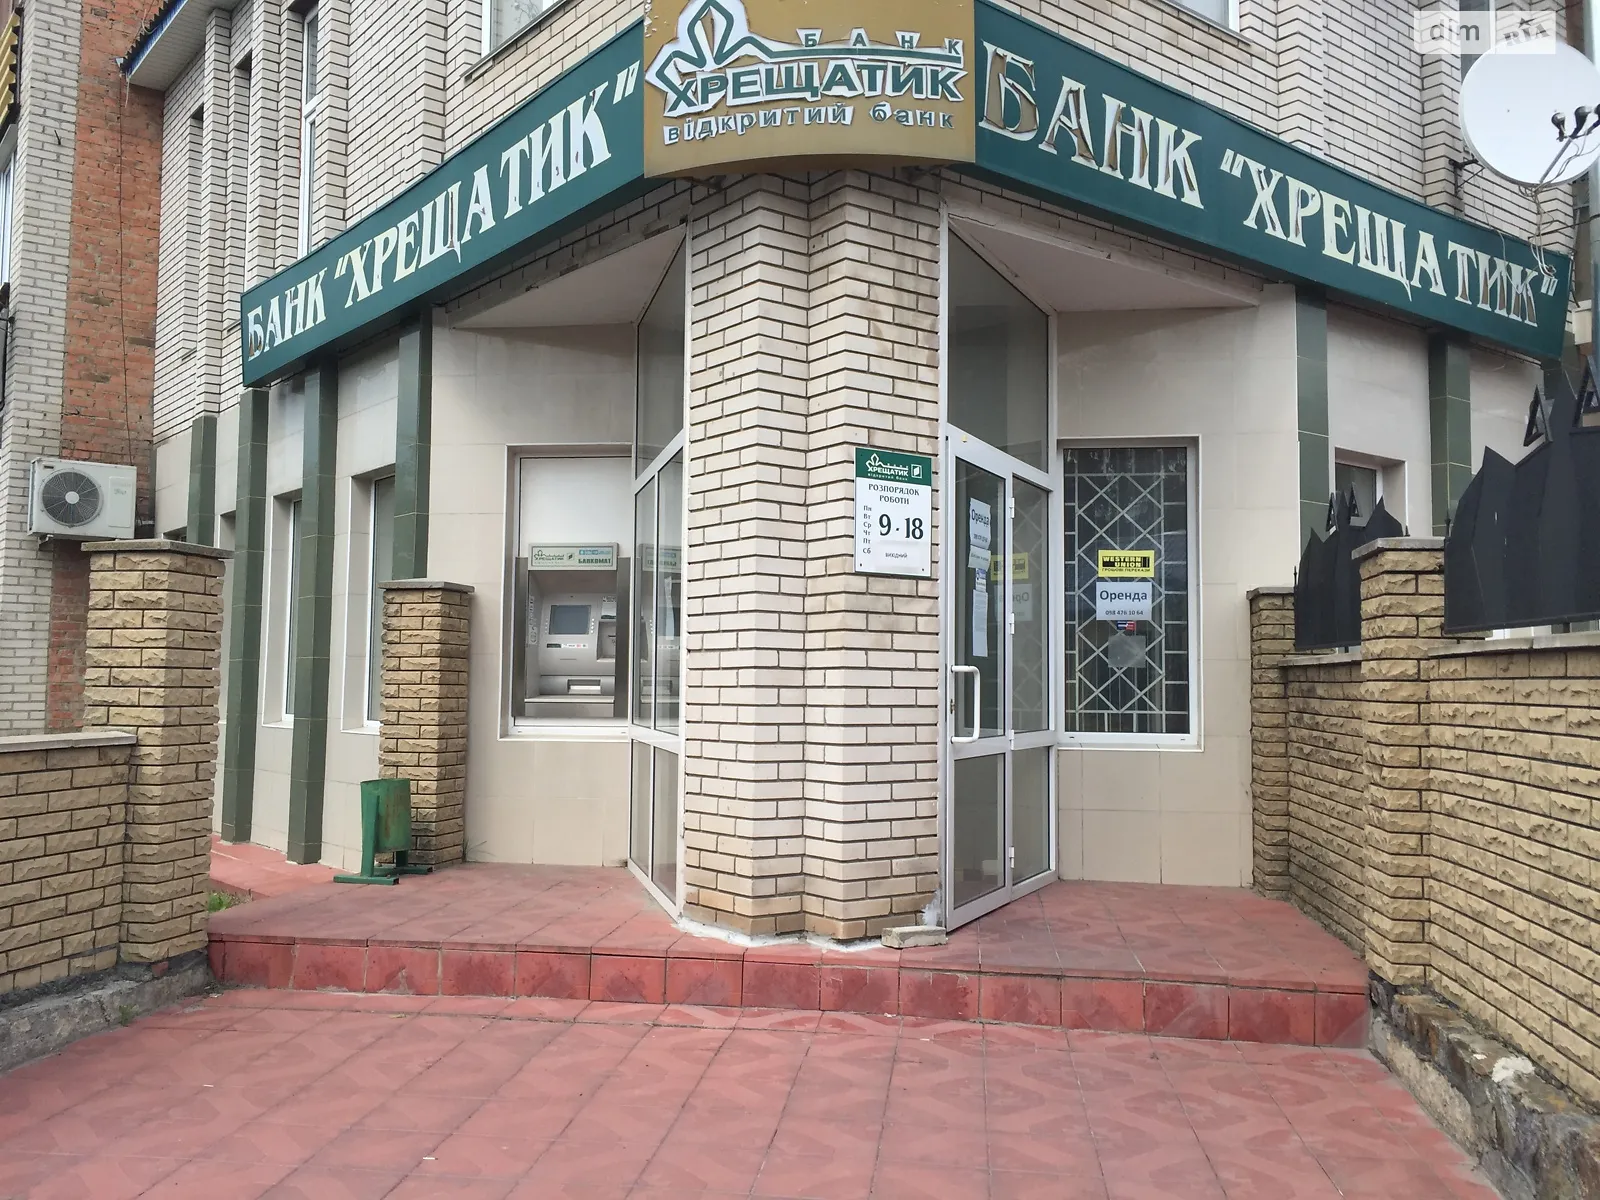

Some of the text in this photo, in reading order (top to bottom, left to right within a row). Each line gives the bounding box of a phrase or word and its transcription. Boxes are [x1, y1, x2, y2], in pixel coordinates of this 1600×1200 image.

[667, 63, 964, 112] ХРЕЩАТИК
[667, 102, 955, 143] відкритий банк
[979, 41, 1205, 209] БАНК
[247, 267, 328, 362] БАНК
[867, 466, 909, 477] ХРЕЩАТИК
[868, 483, 920, 496] РОЗПОРЯДОК
[879, 495, 910, 505] РОБОТИ
[863, 521, 872, 529] Ср
[1100, 590, 1147, 603] Оренда
